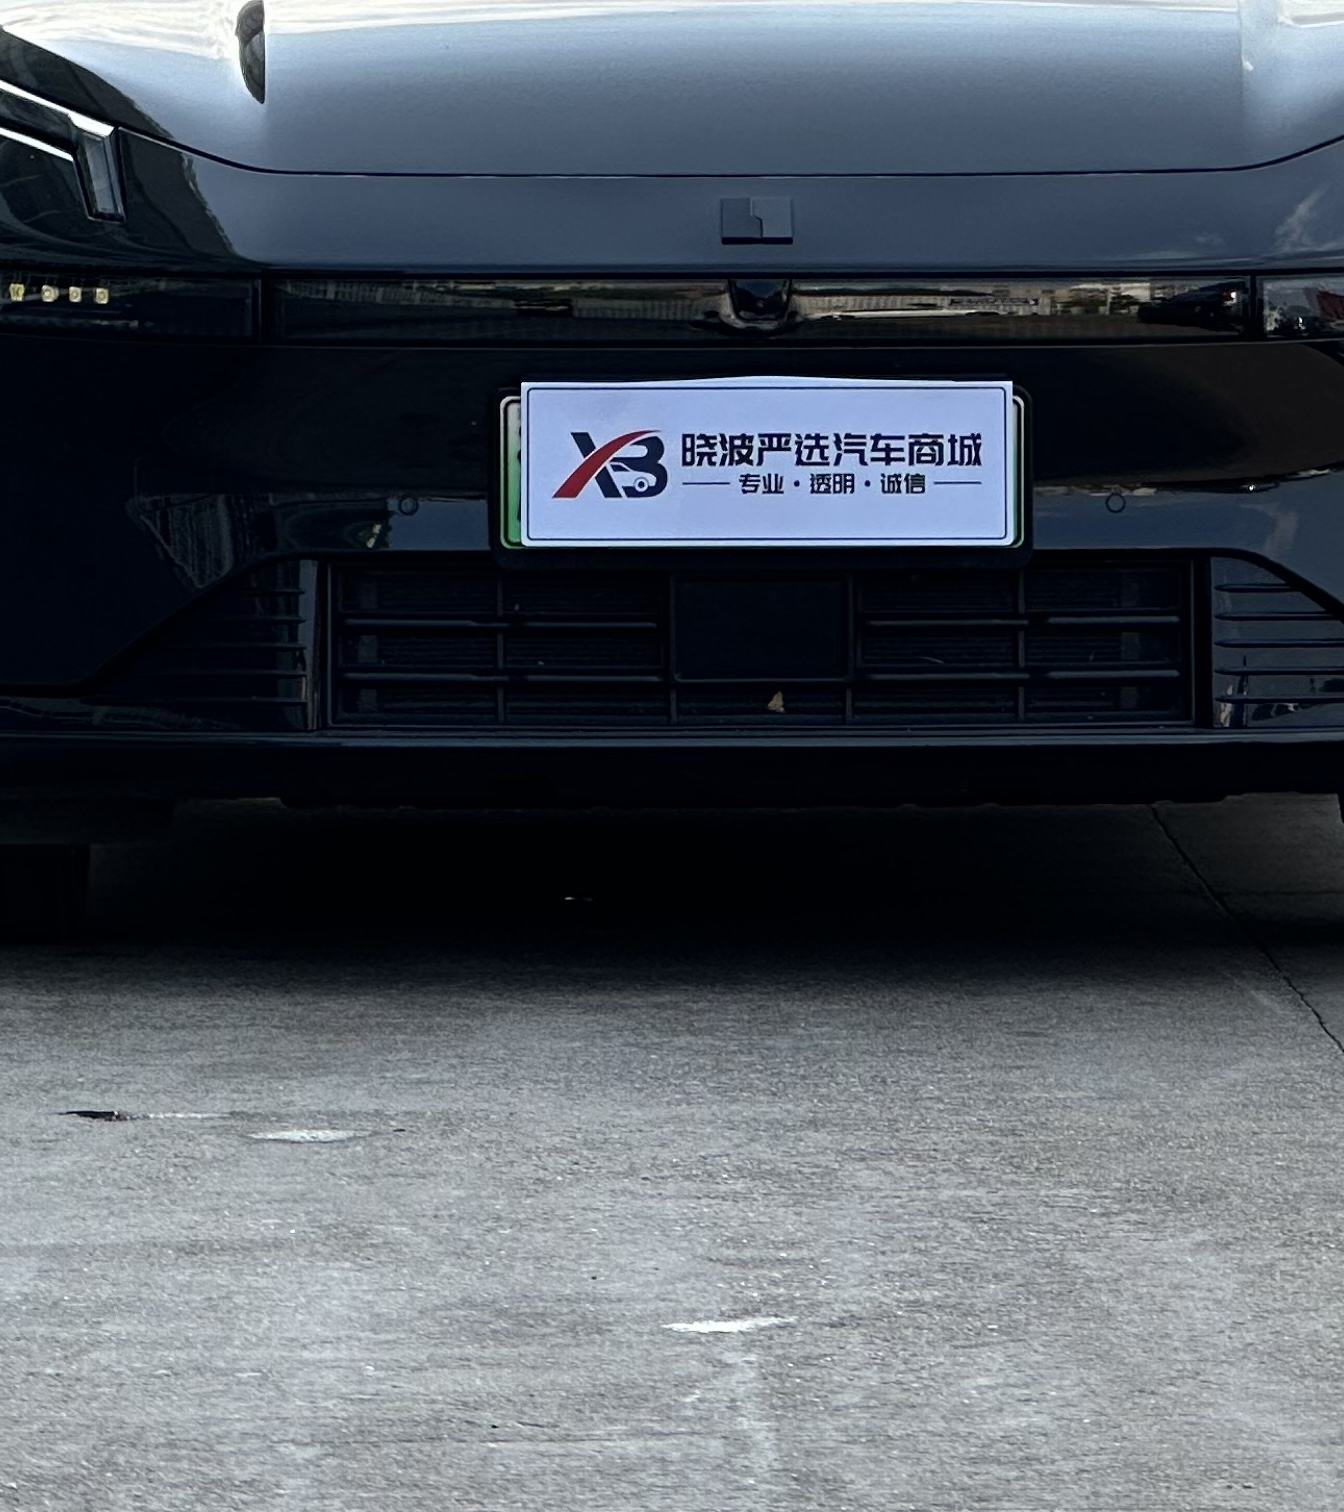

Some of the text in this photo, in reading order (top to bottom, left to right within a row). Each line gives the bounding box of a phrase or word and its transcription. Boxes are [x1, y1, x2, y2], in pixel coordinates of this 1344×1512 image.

[681, 432, 982, 467] 晓波严选汽车商城
